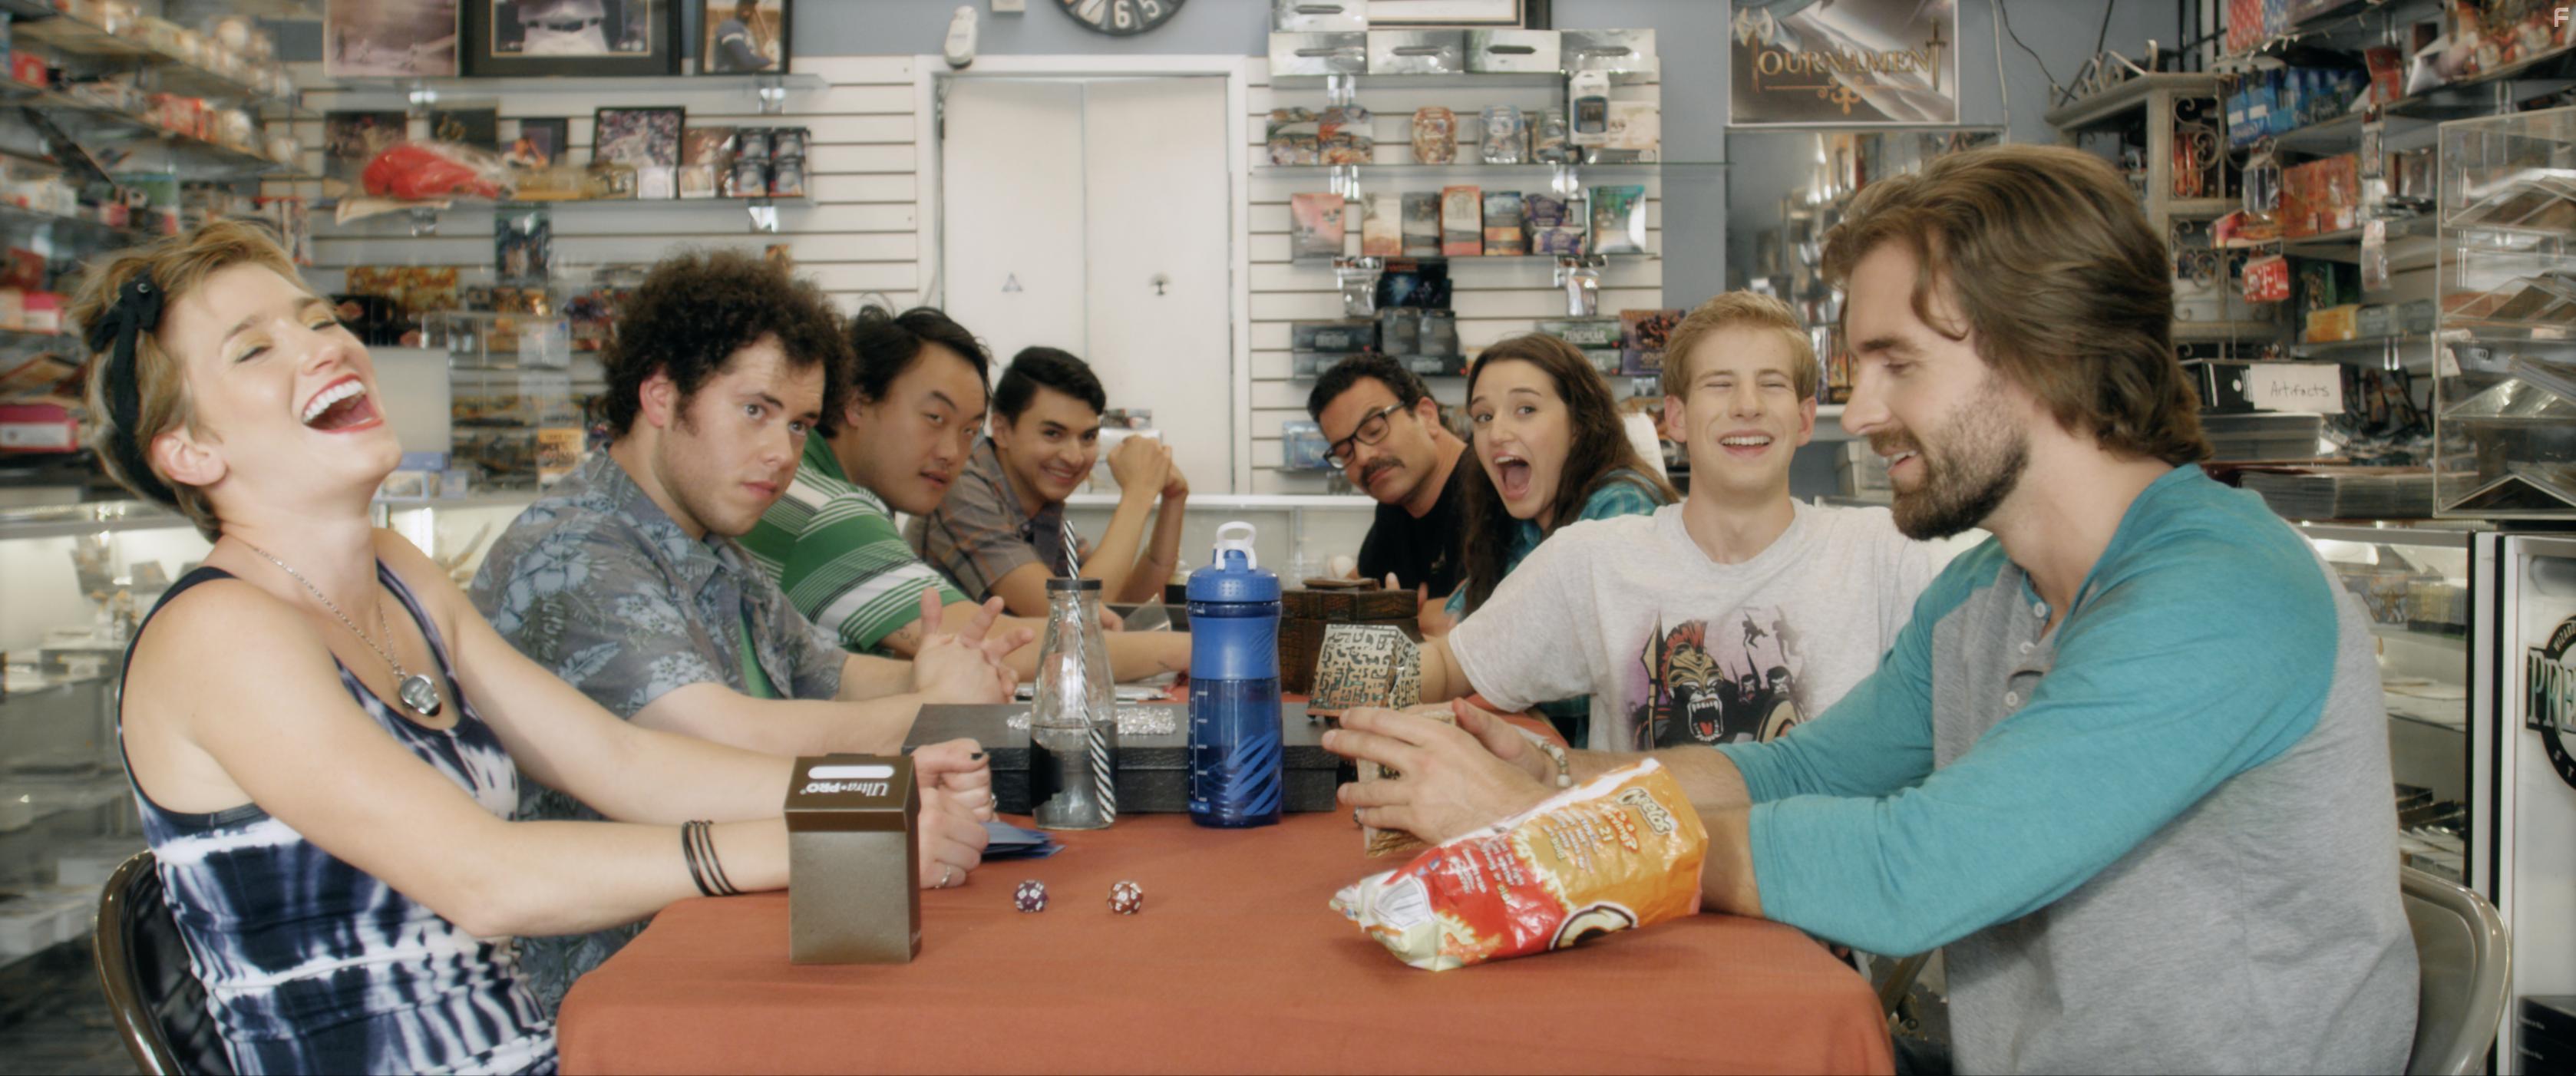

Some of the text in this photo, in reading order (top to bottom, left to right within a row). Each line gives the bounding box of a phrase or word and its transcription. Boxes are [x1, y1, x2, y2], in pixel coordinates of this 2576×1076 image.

[1115, 0, 1131, 28] 6
[1141, 0, 1161, 18] 5
[1738, 28, 1945, 92] TOURNAMENT
[2271, 381, 2330, 398] Artifacts
[1615, 787, 1673, 835] Cheetos
[1599, 827, 1613, 842] 21
